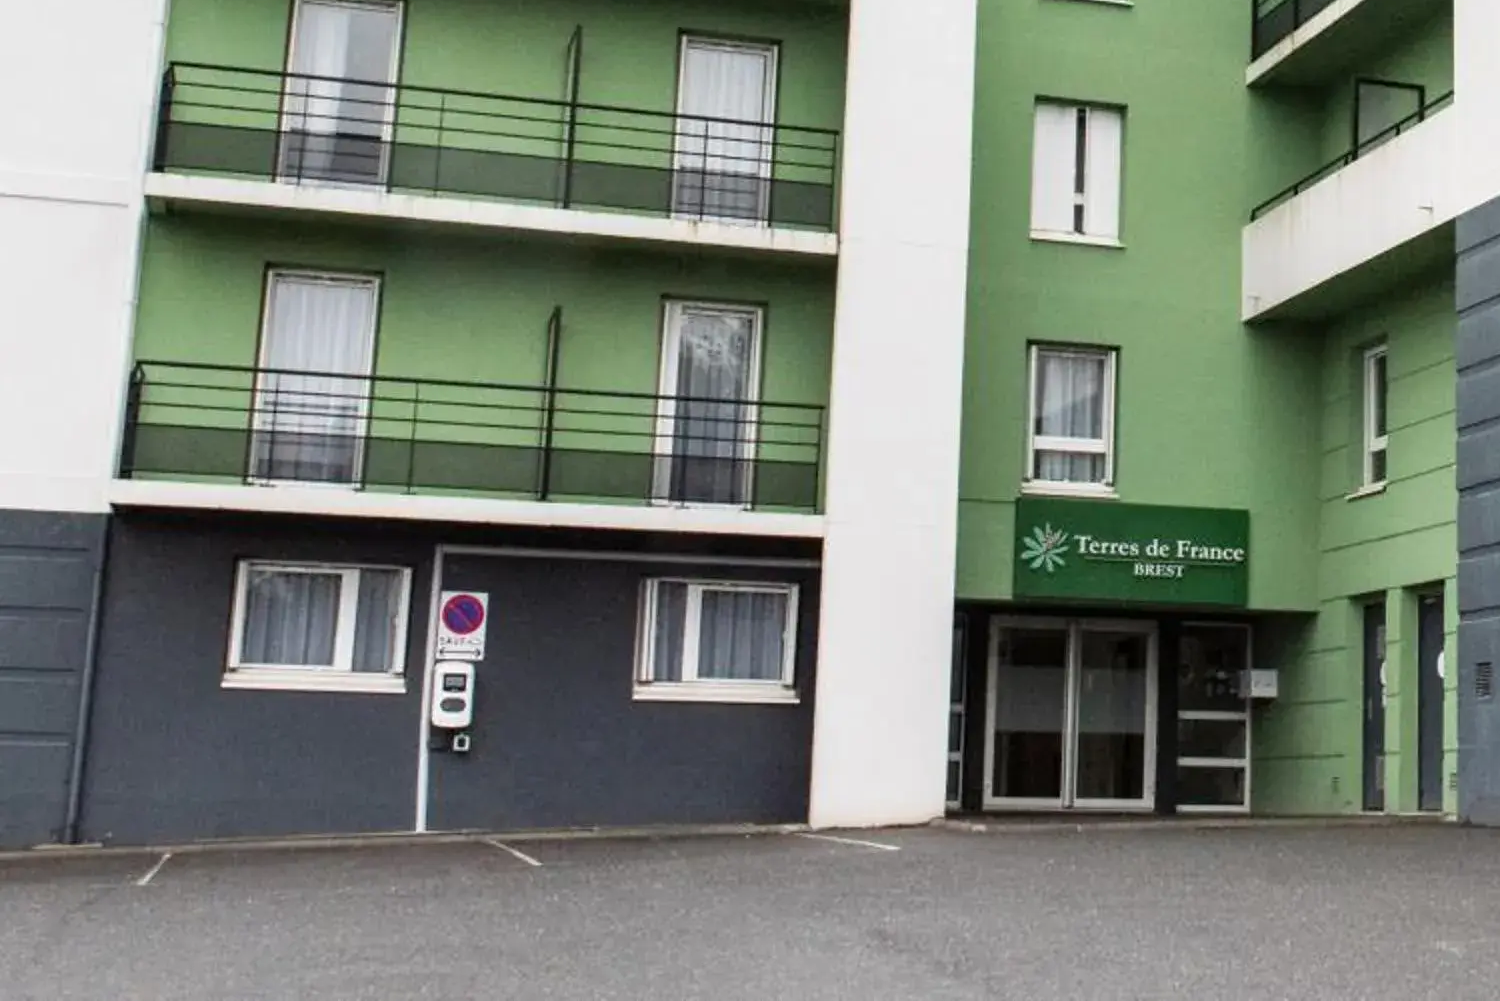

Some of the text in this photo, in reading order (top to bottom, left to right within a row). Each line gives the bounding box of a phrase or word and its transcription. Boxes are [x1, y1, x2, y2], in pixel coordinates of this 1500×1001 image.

[1073, 535, 1245, 562] Terres de France
[1133, 563, 1185, 578] BREST
